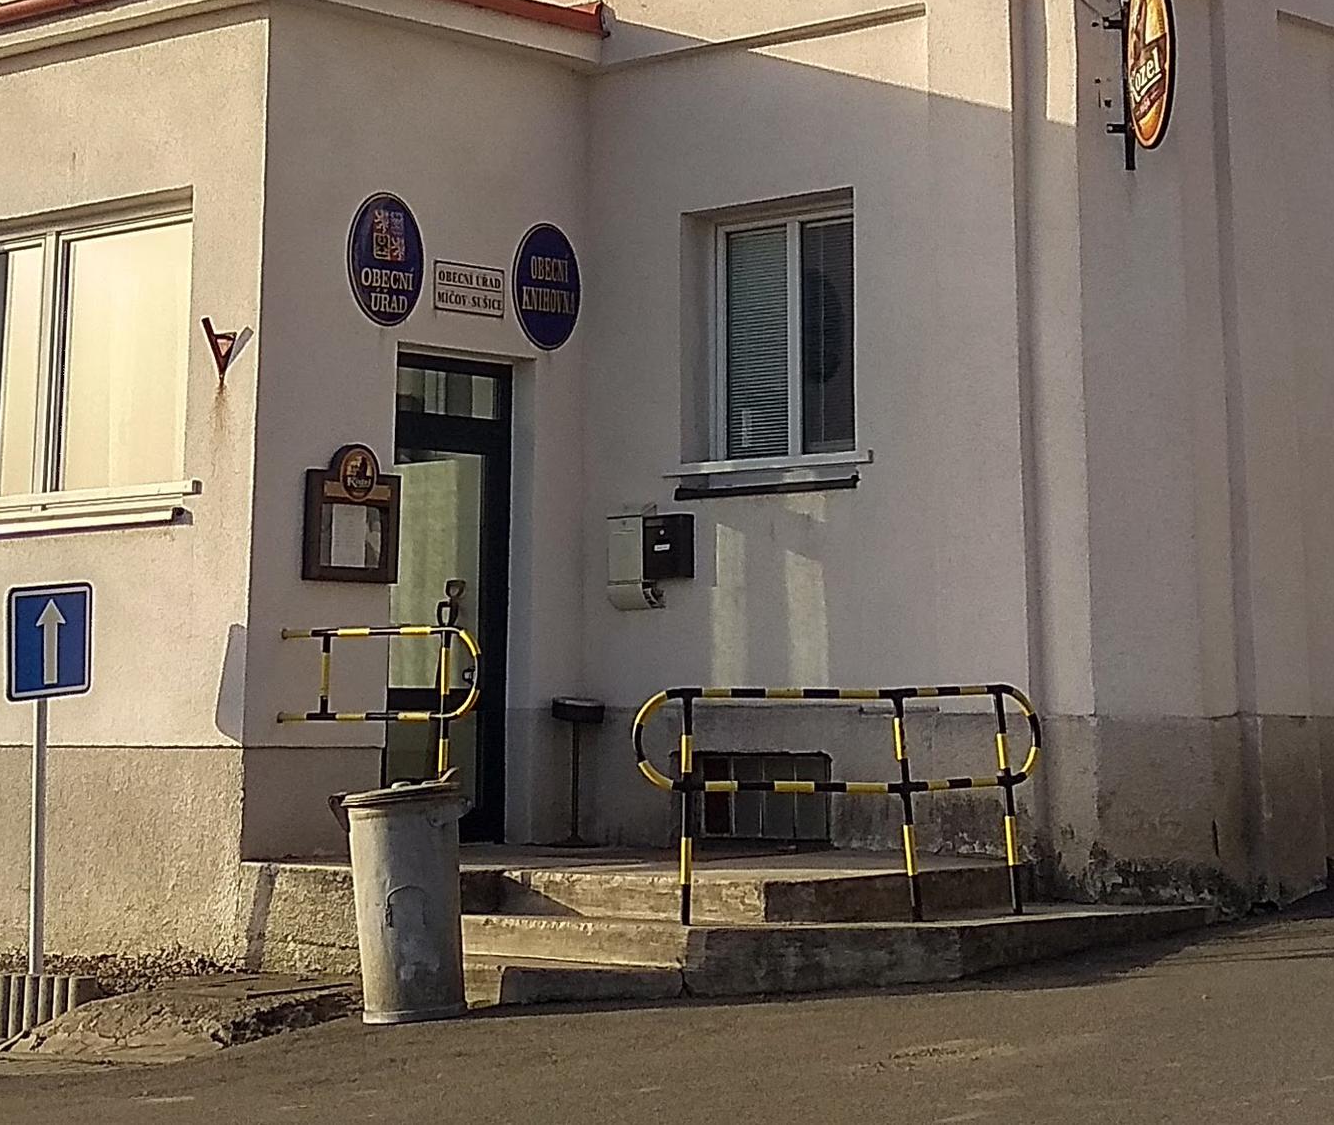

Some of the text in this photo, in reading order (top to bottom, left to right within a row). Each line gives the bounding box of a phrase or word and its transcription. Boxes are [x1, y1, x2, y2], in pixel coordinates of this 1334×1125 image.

[361, 267, 414, 291] OBECNÍ
[370, 287, 409, 313] ÚŘAD
[522, 286, 576, 315] KNIHOVNA
